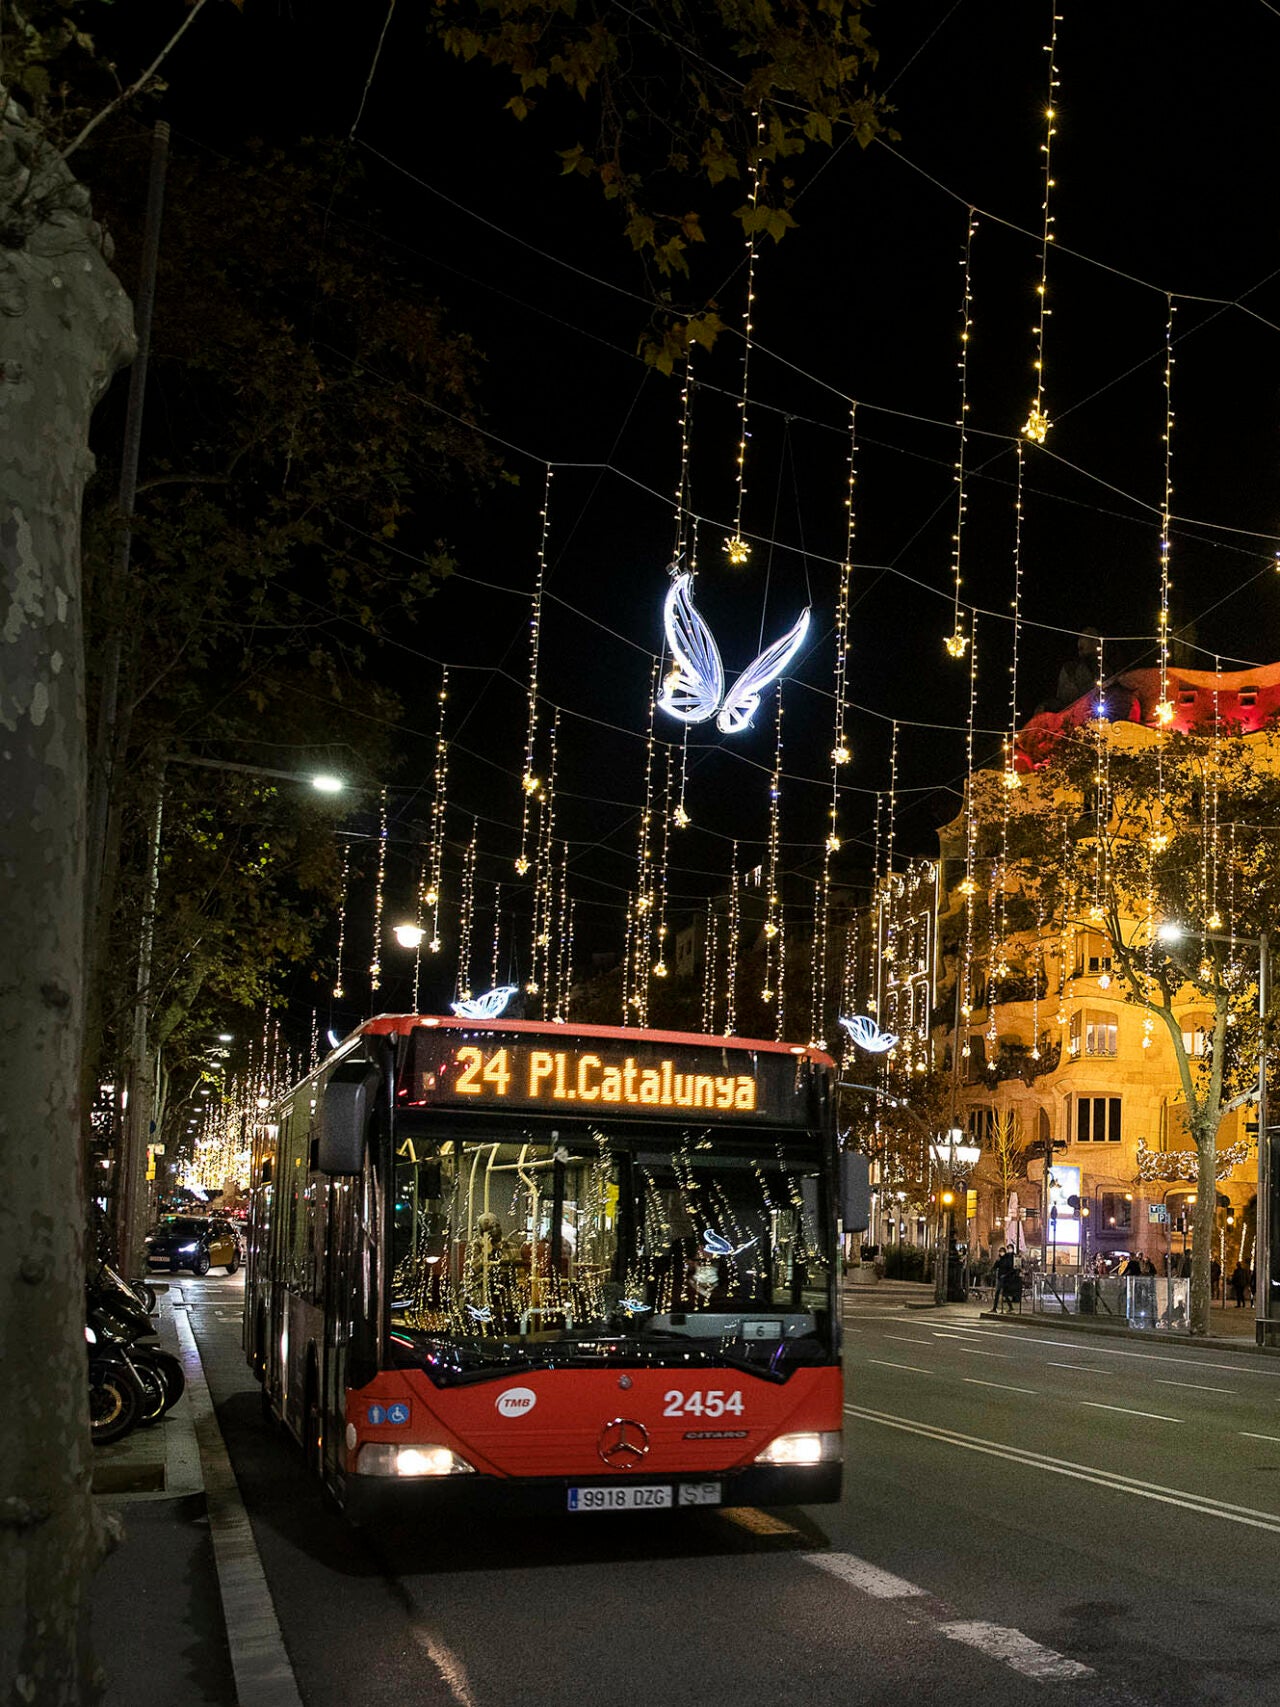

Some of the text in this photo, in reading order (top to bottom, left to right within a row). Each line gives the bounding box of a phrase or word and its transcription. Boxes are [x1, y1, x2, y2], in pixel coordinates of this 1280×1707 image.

[455, 1046, 756, 1110] 24 Pl.Catalunya
[756, 1326, 765, 1337] 6
[503, 1398, 531, 1408] TMB
[662, 1390, 745, 1417] 2454
[583, 1488, 665, 1508] 9918 DZG
